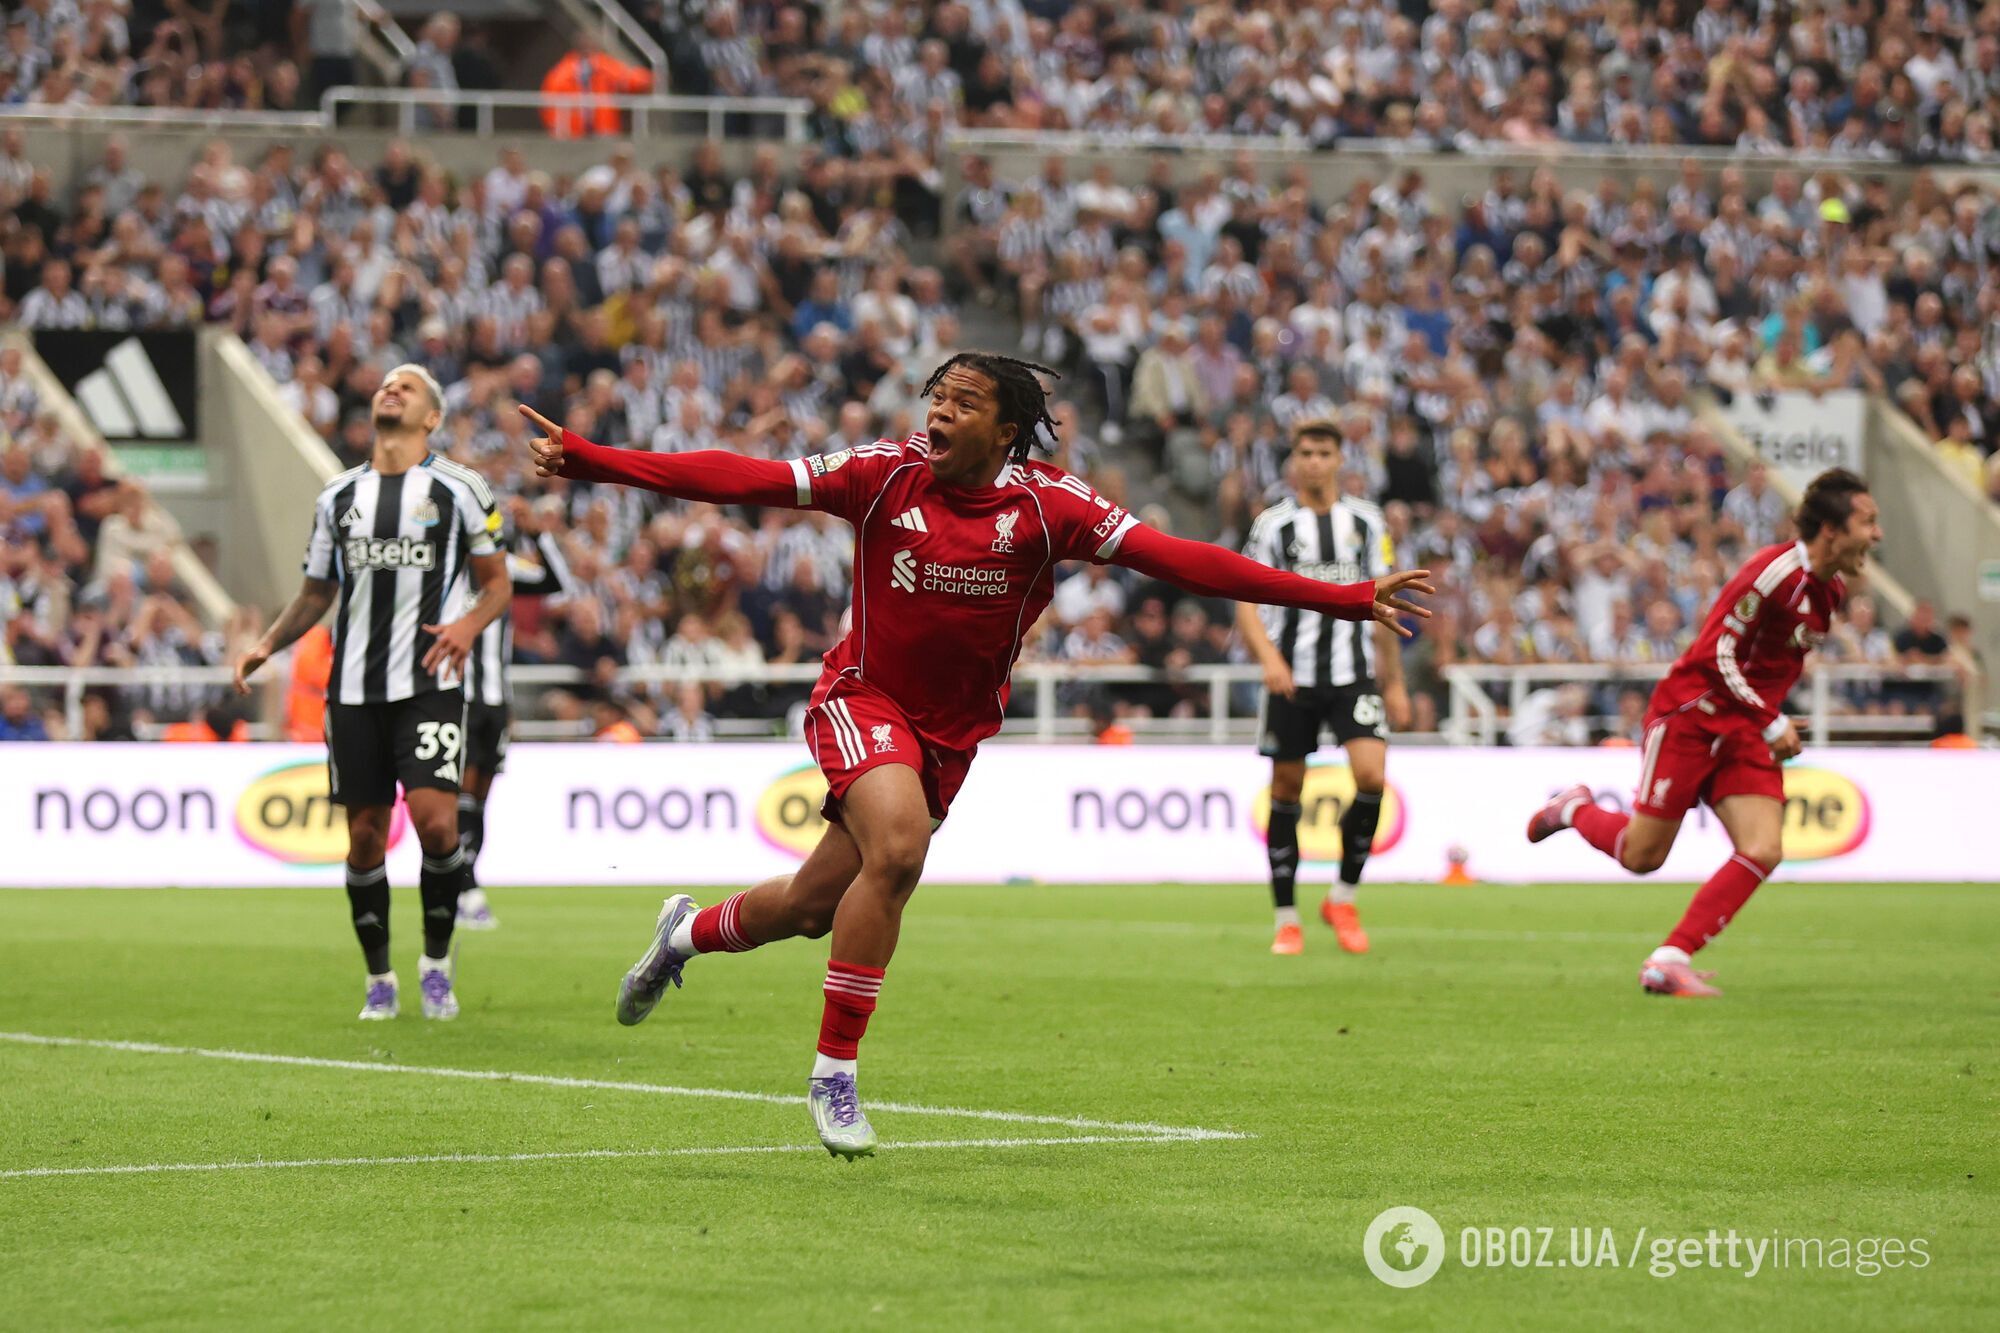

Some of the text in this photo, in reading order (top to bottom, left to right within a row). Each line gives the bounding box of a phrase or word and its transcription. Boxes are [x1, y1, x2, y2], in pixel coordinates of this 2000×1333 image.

[922, 577, 1009, 596] chartered
[923, 561, 1007, 582] standard
[415, 721, 461, 761] 39
[35, 789, 335, 832] noon on
[568, 789, 739, 831] noon
[1072, 790, 1236, 831] noon
[1782, 795, 1845, 829] ne
